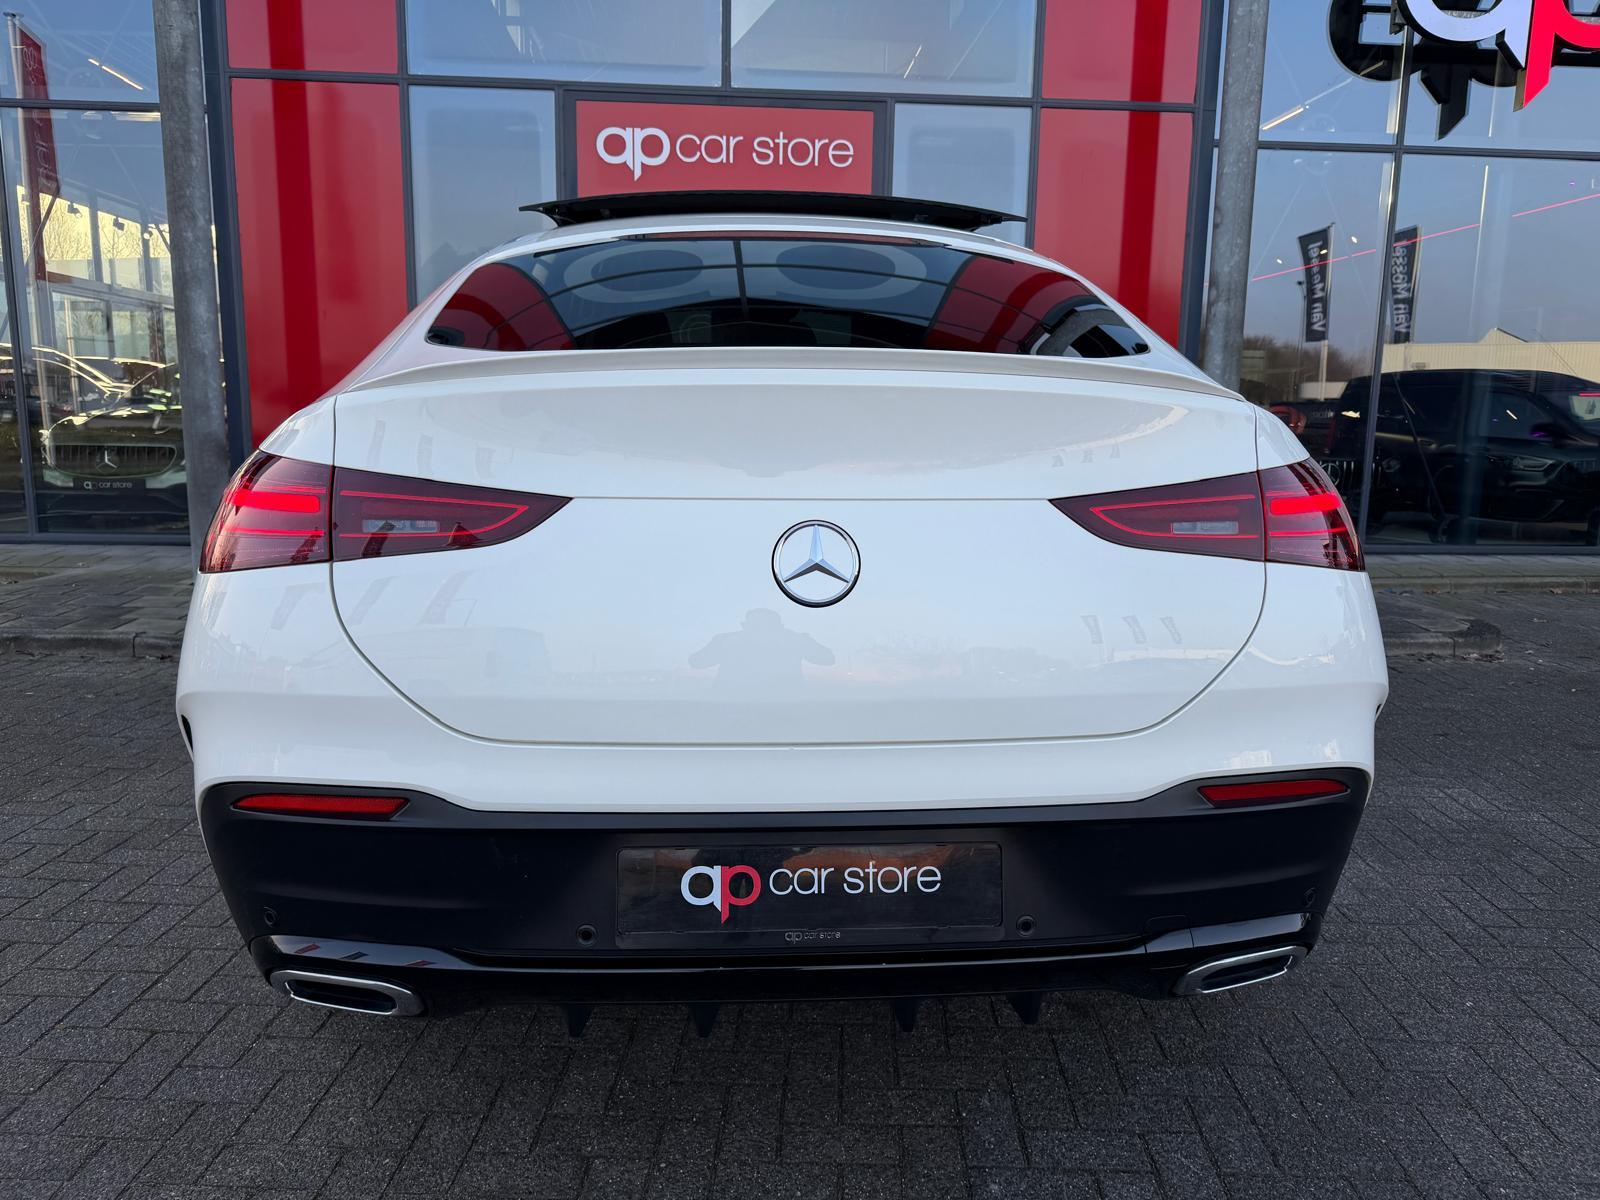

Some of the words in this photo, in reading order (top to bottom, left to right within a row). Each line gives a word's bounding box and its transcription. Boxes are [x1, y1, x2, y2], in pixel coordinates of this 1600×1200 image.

[596, 127, 671, 182] ap
[676, 134, 744, 164] car
[752, 131, 854, 167] store
[680, 864, 762, 924] ap
[769, 866, 834, 895] car
[843, 861, 942, 894] store
